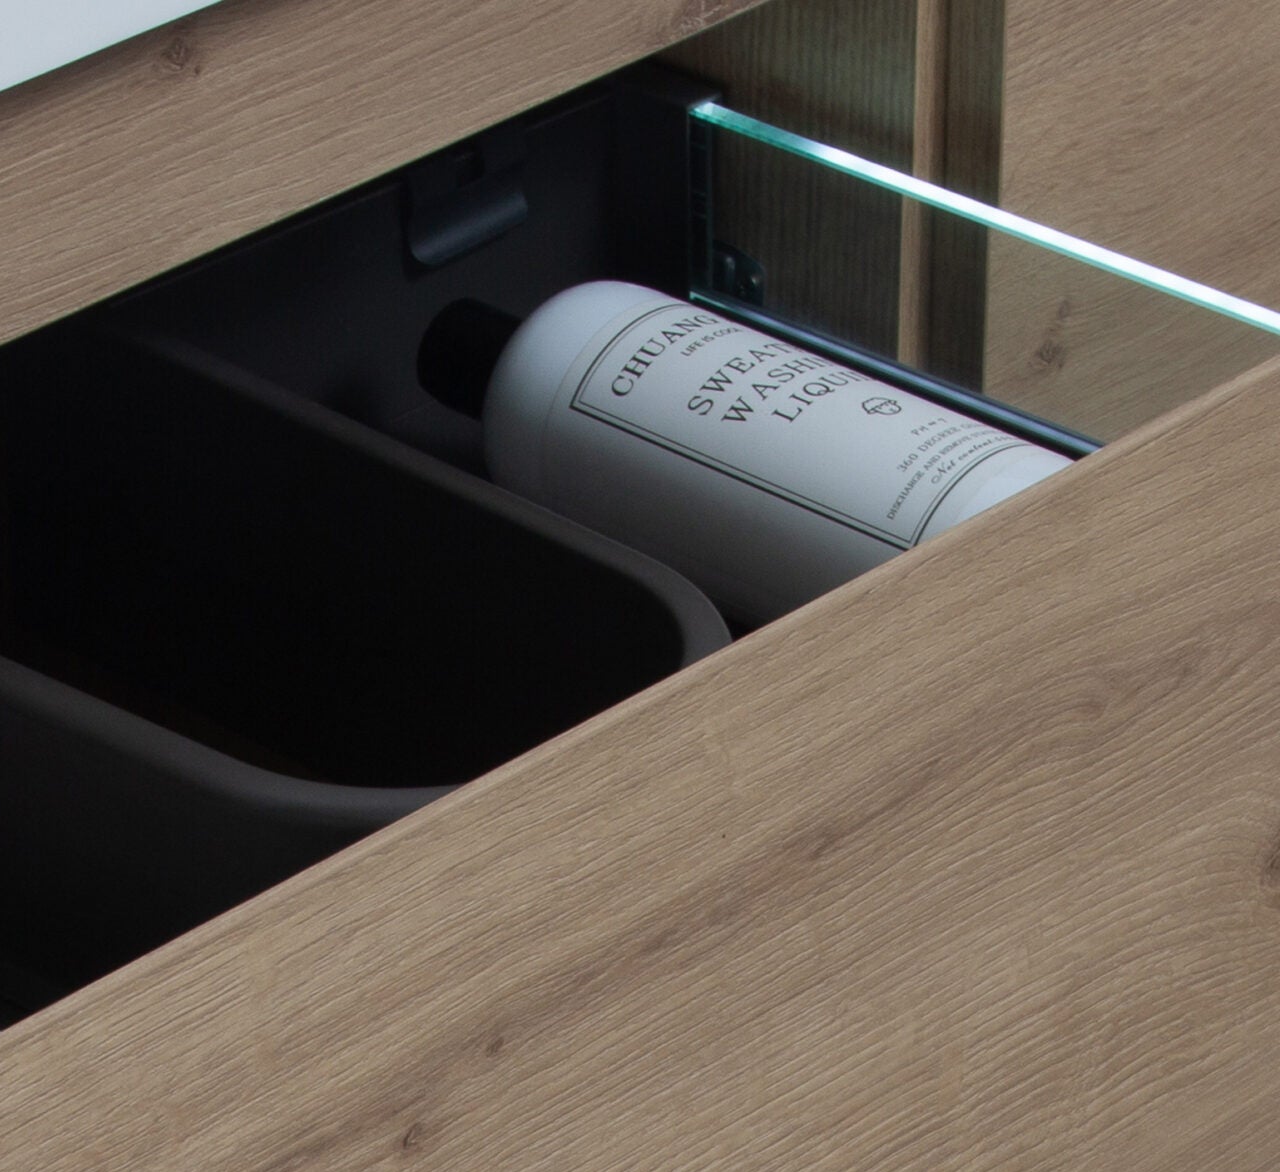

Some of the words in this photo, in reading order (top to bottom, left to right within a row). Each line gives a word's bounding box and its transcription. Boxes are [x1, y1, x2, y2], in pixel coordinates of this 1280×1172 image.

[610, 314, 720, 398] CHUANG
[680, 340, 705, 357] LIFE
[896, 454, 919, 473] 360
[917, 426, 962, 453] DEGREE
[885, 470, 926, 521] DISCHARGE
[923, 454, 942, 471] AND
